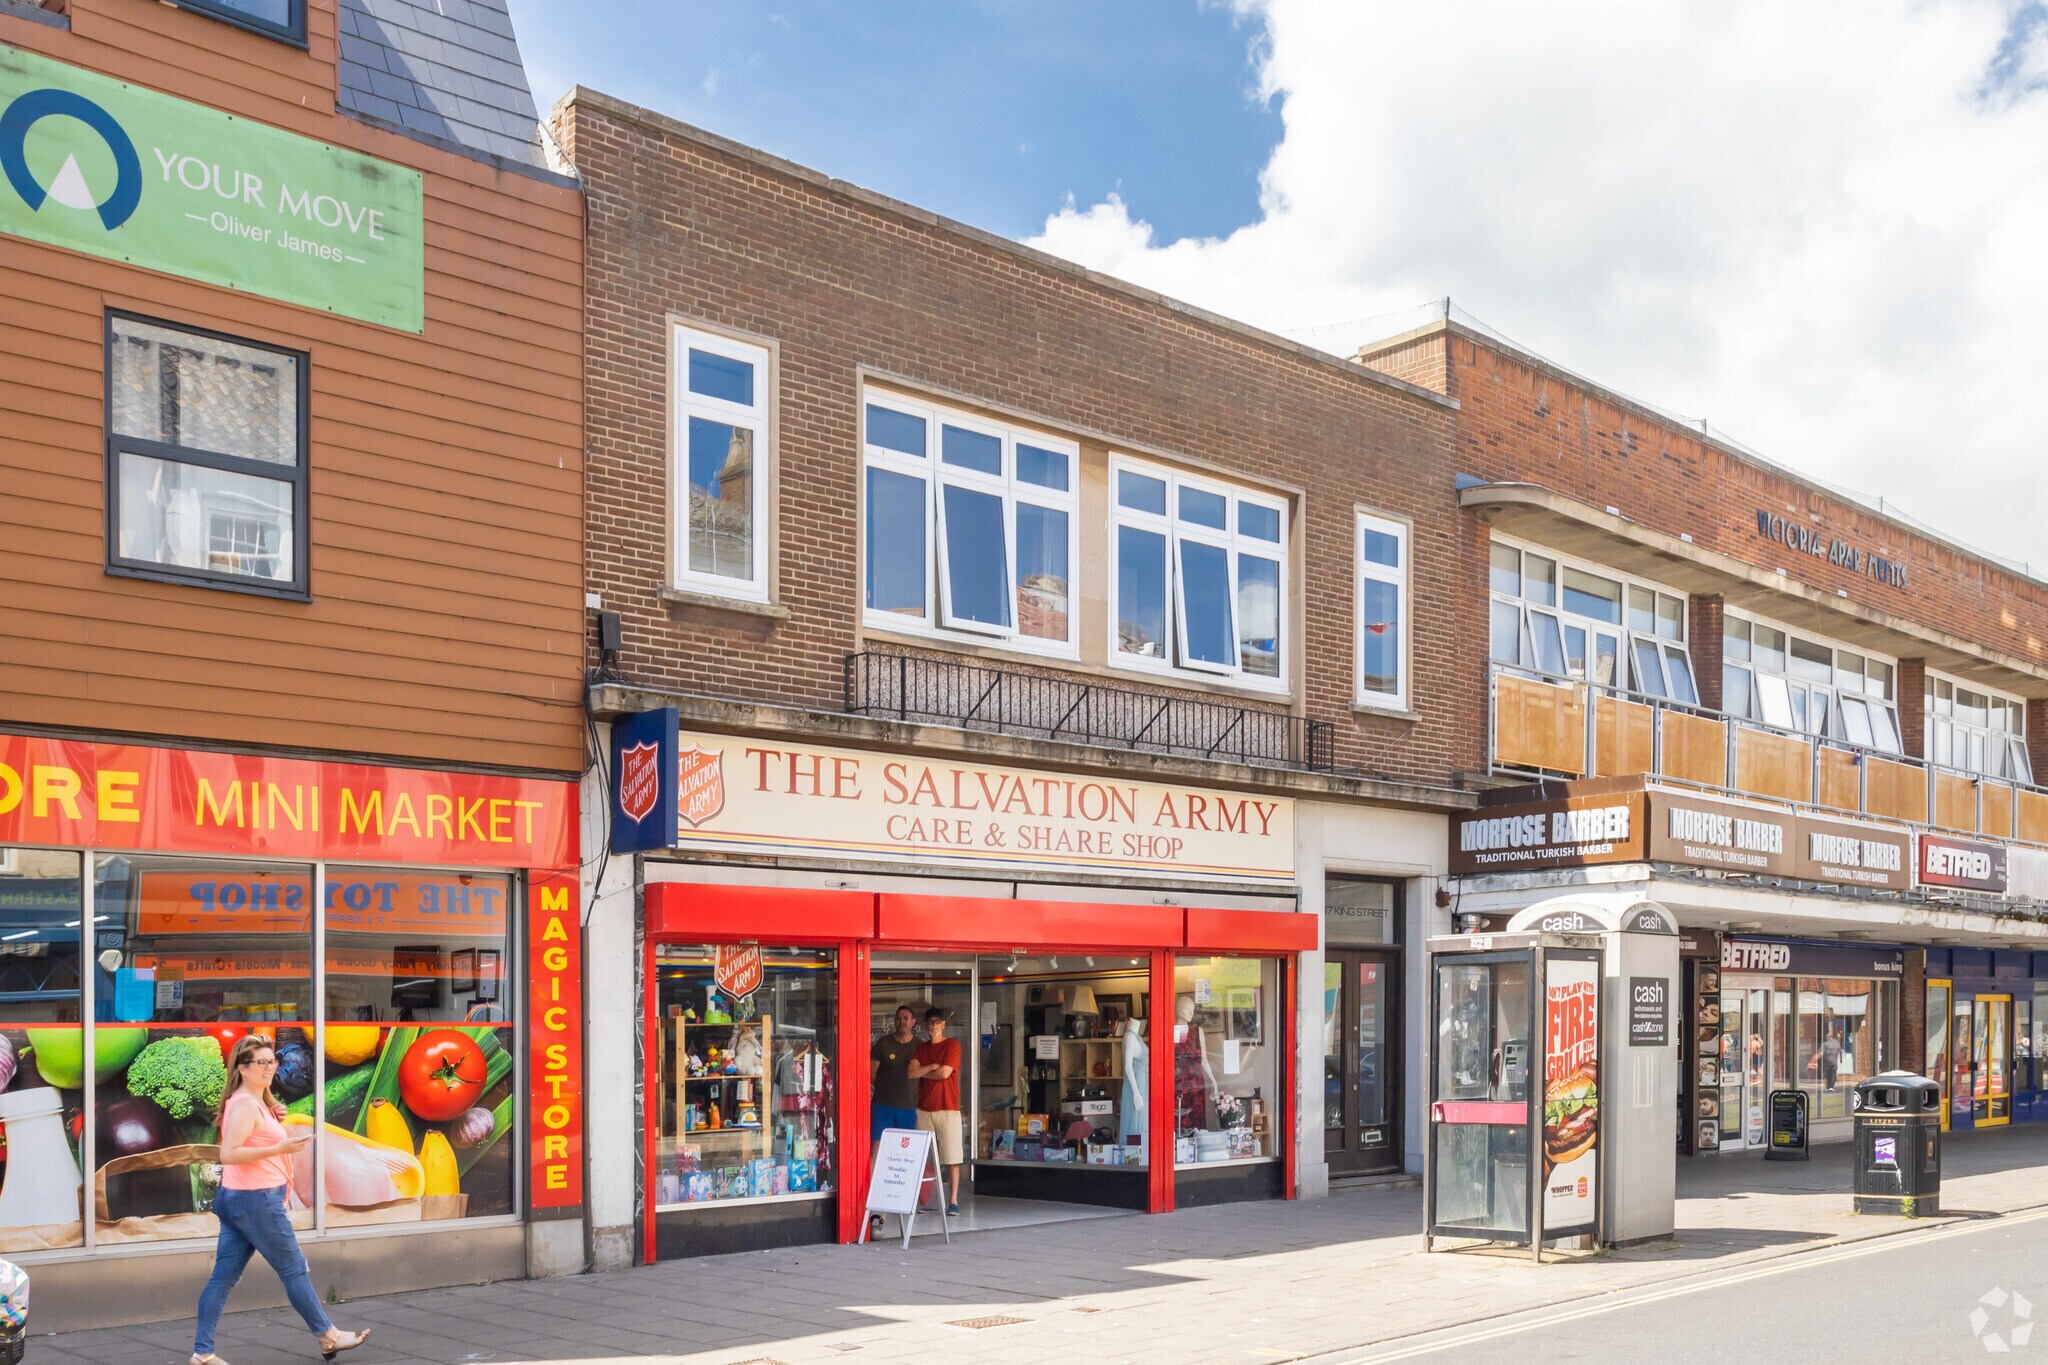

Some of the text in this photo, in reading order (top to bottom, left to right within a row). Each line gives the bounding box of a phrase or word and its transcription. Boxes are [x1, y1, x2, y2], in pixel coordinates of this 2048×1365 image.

[153, 147, 384, 241] YOUR MOVE
[210, 211, 342, 262] Oliver James
[1757, 508, 1822, 559] VICTORIA
[622, 751, 657, 804] SALVATION
[628, 751, 643, 776] THE
[678, 750, 699, 776] THE
[678, 757, 719, 800] ALVATION
[196, 778, 319, 832] MINI
[339, 788, 543, 844] MARKET
[633, 775, 654, 812] ARMY
[687, 780, 718, 817] ARMY
[745, 748, 1279, 837] THE SALVATION ARMY
[886, 814, 1183, 860] CARE & SHARE SHOP
[1460, 805, 1630, 851] MORFOSE BARBER
[1669, 807, 1783, 855] MORFOSE BARBER
[1475, 843, 1613, 864] TRADITIONAL TURKISH BARBER
[1684, 846, 1768, 867] TRADITIONAL TURKISH BARBER
[1810, 832, 1900, 872] MORFOSE BARBER
[1926, 844, 1991, 881] BETFRED
[1821, 866, 1888, 883] TRADITIONAL TURKISH BARBER
[1334, 906, 1355, 916] KING
[1356, 908, 1389, 918] STREET
[1542, 912, 1584, 931] cash
[1639, 913, 1661, 930] cash
[718, 945, 758, 984] SALVATION
[1721, 941, 1790, 970] BETFRED
[1874, 961, 1902, 973] bonus king
[733, 961, 757, 993] ARMY
[1562, 982, 1582, 998] PLAY
[1634, 981, 1663, 1003] cash
[540, 886, 570, 1189] MAGIC STORE
[1548, 993, 1595, 1055] FIRE
[1547, 1043, 1583, 1081] GRILL
[888, 1165, 907, 1173] Monday
